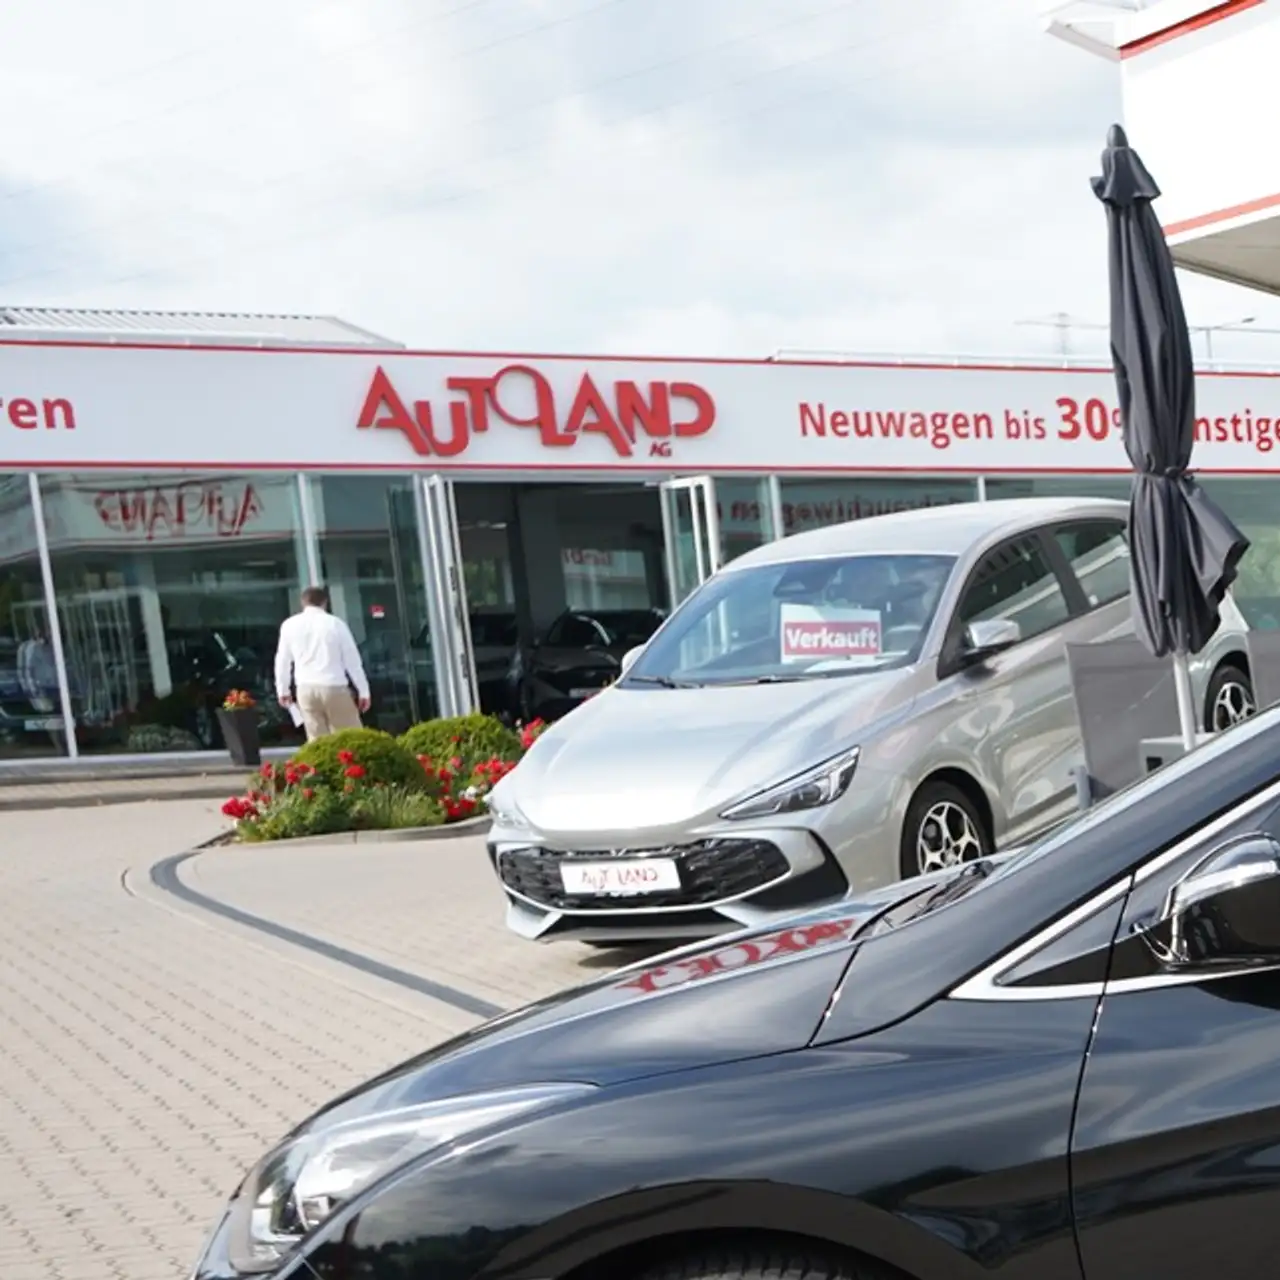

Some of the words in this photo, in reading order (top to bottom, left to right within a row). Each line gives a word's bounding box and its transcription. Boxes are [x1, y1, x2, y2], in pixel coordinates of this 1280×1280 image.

[0, 397, 76, 430] en
[356, 364, 716, 457] AUTOLAND
[798, 401, 994, 449] Neuwagen
[1004, 409, 1047, 440] bis
[649, 441, 673, 457] AG
[786, 627, 878, 649] Verkauft
